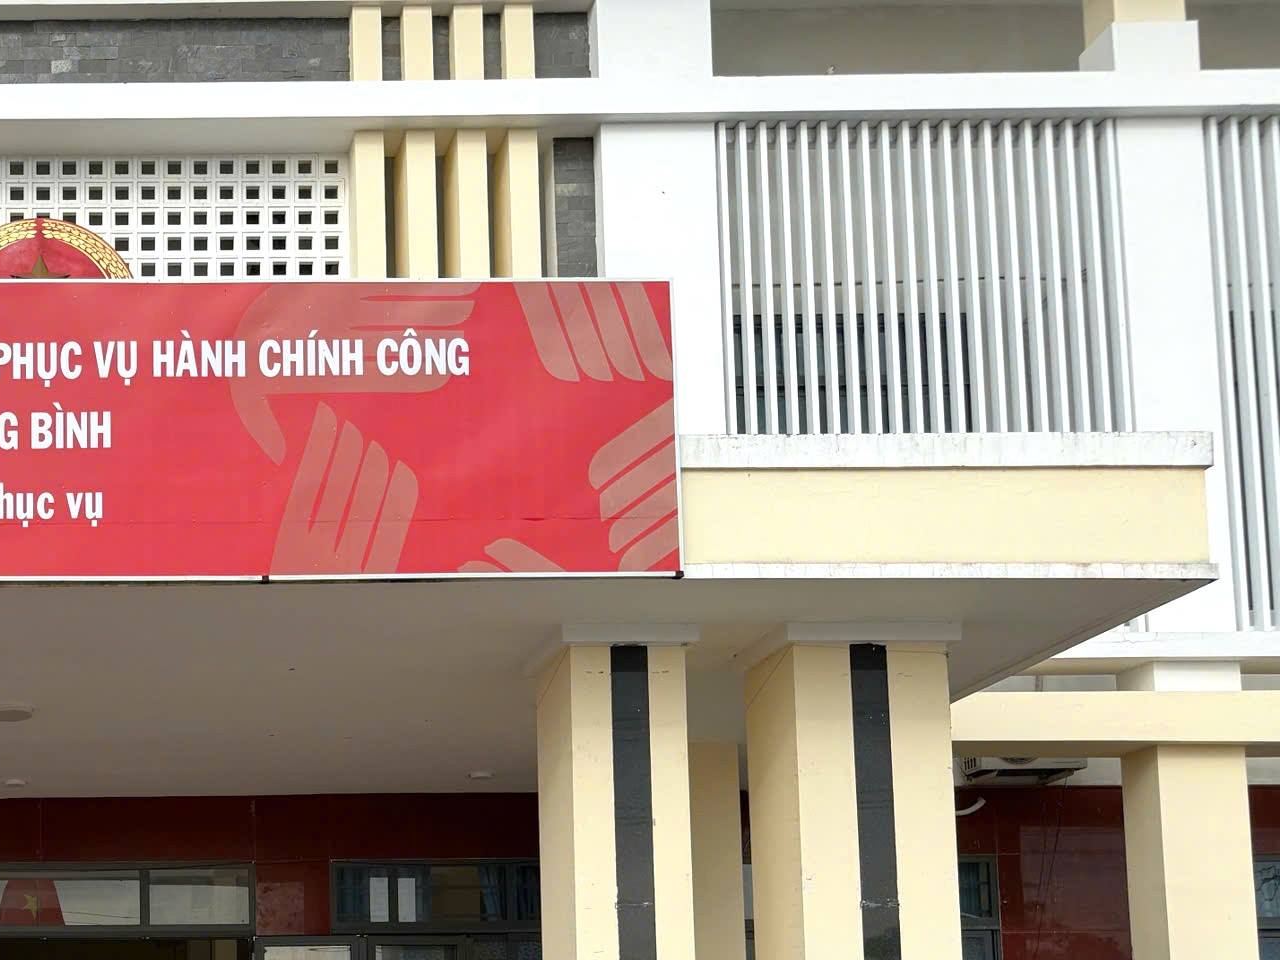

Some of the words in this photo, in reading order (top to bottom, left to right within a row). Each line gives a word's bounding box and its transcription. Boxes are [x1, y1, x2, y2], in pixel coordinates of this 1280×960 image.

[93, 340, 138, 386] VỤ
[152, 329, 246, 378] HÀNH
[258, 329, 364, 378] CHÍNH
[376, 327, 470, 377] CÔNG
[30, 401, 112, 450] BÌNH
[65, 491, 103, 528] vụ
